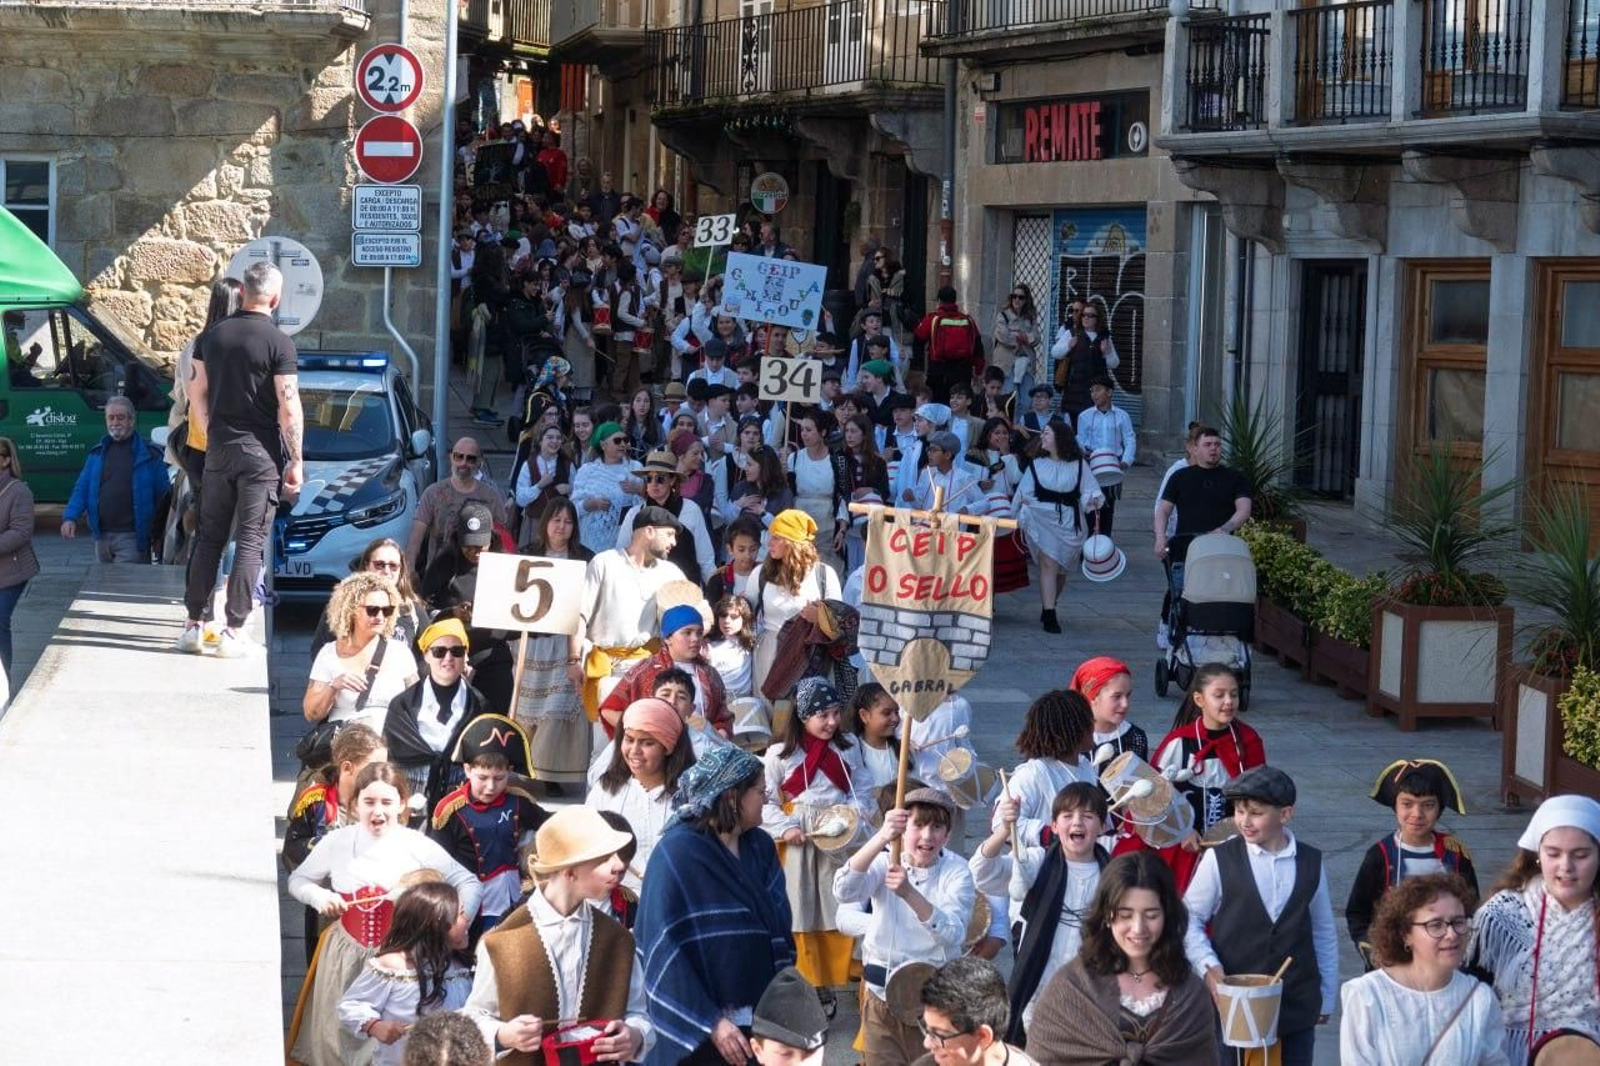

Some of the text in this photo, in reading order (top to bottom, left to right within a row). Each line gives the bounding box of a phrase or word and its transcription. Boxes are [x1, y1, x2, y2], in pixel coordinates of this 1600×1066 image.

[1025, 101, 1101, 161] REMATE
[360, 196, 381, 204] CARGA
[374, 189, 402, 197] EXCEPTO
[697, 216, 731, 243] 33
[757, 262, 801, 279] CEIP
[764, 359, 817, 398] 34
[45, 411, 77, 423] dislog
[889, 528, 977, 562] CEIP
[285, 560, 312, 575] LVD
[510, 559, 554, 623] 5
[868, 565, 988, 601] O SELLO
[889, 679, 956, 695] CABRAL
